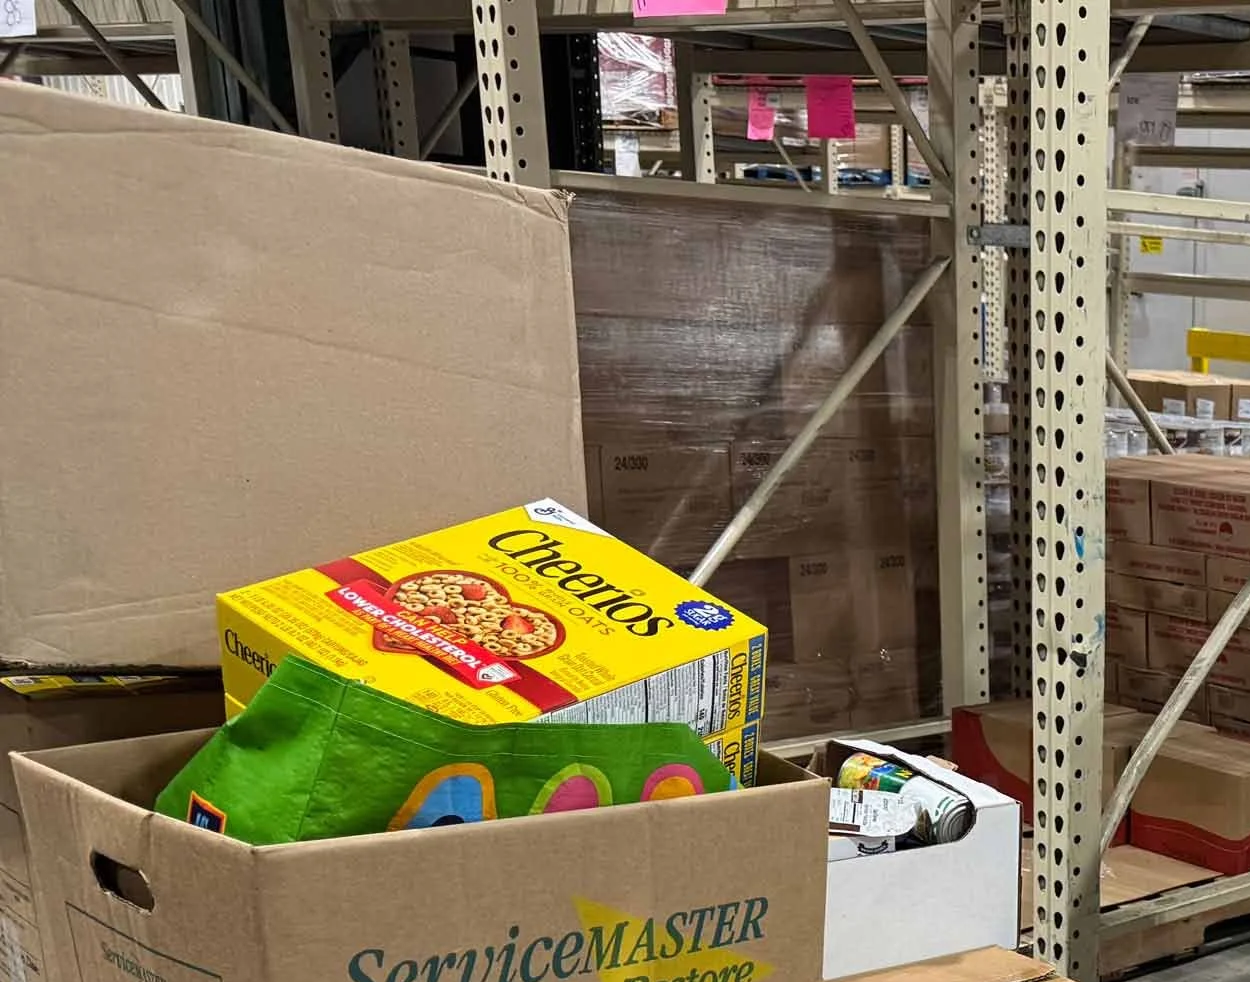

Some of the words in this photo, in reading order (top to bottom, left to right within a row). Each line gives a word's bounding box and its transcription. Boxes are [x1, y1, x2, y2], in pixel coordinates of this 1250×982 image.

[487, 529, 675, 637] Cheerios
[338, 587, 386, 619] LOWER
[382, 614, 482, 670] CHOLESTEROL
[567, 606, 616, 636] OATS
[728, 652, 747, 720] Cheerios
